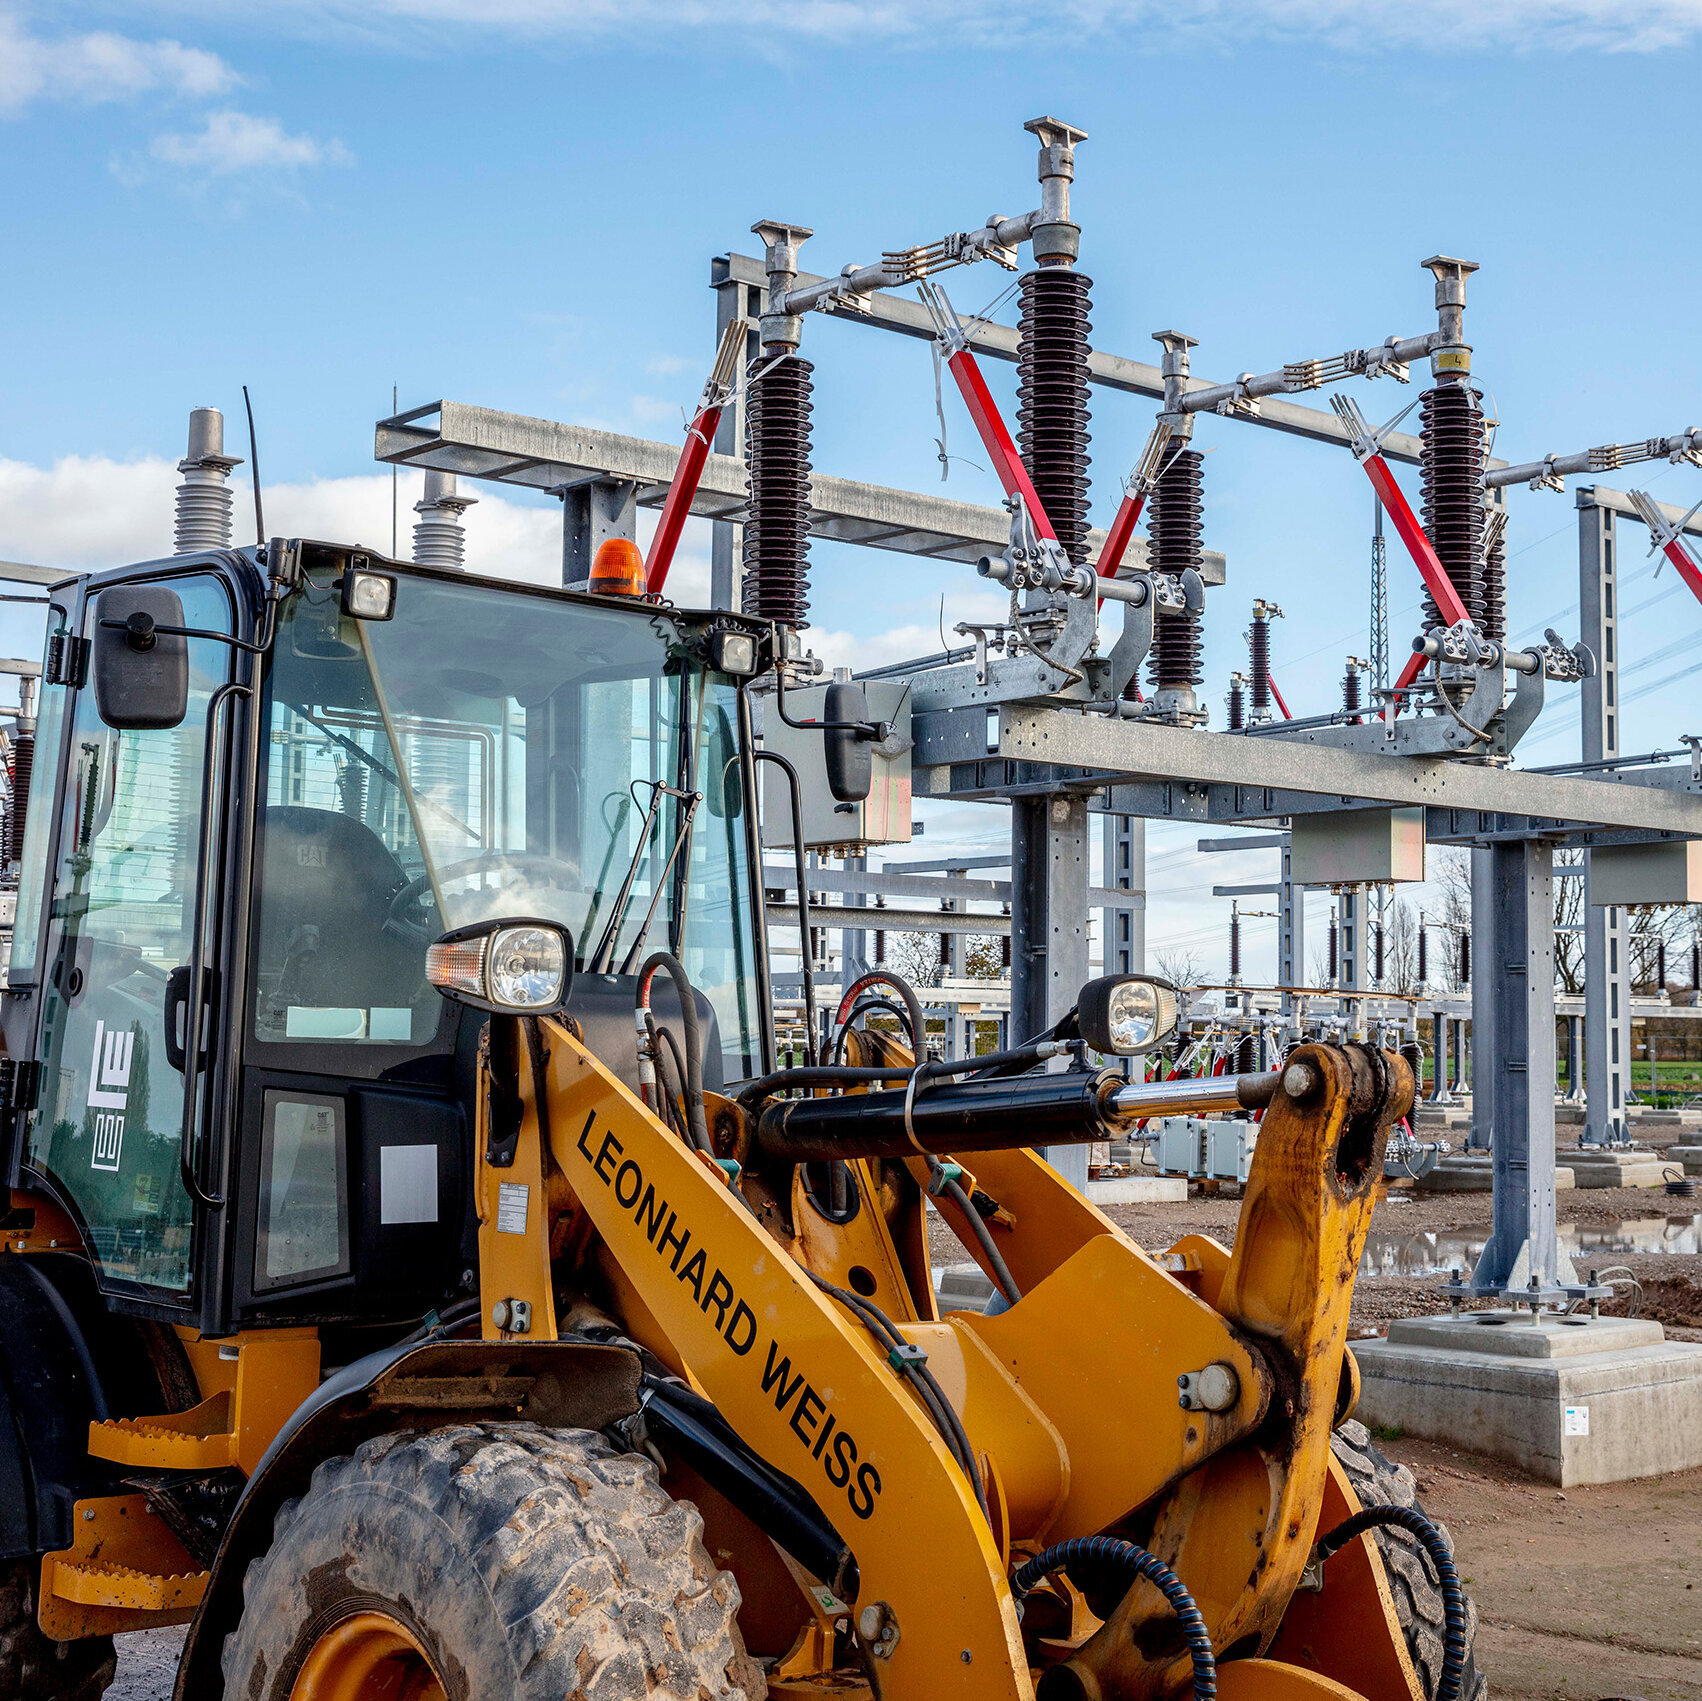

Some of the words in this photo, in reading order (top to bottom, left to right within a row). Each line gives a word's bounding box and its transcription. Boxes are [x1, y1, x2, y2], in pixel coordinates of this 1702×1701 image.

[1454, 355, 1462, 366] 4
[297, 844, 328, 868] CAT
[577, 1109, 757, 1356] LEONHARD
[760, 1339, 882, 1520] WEISS
